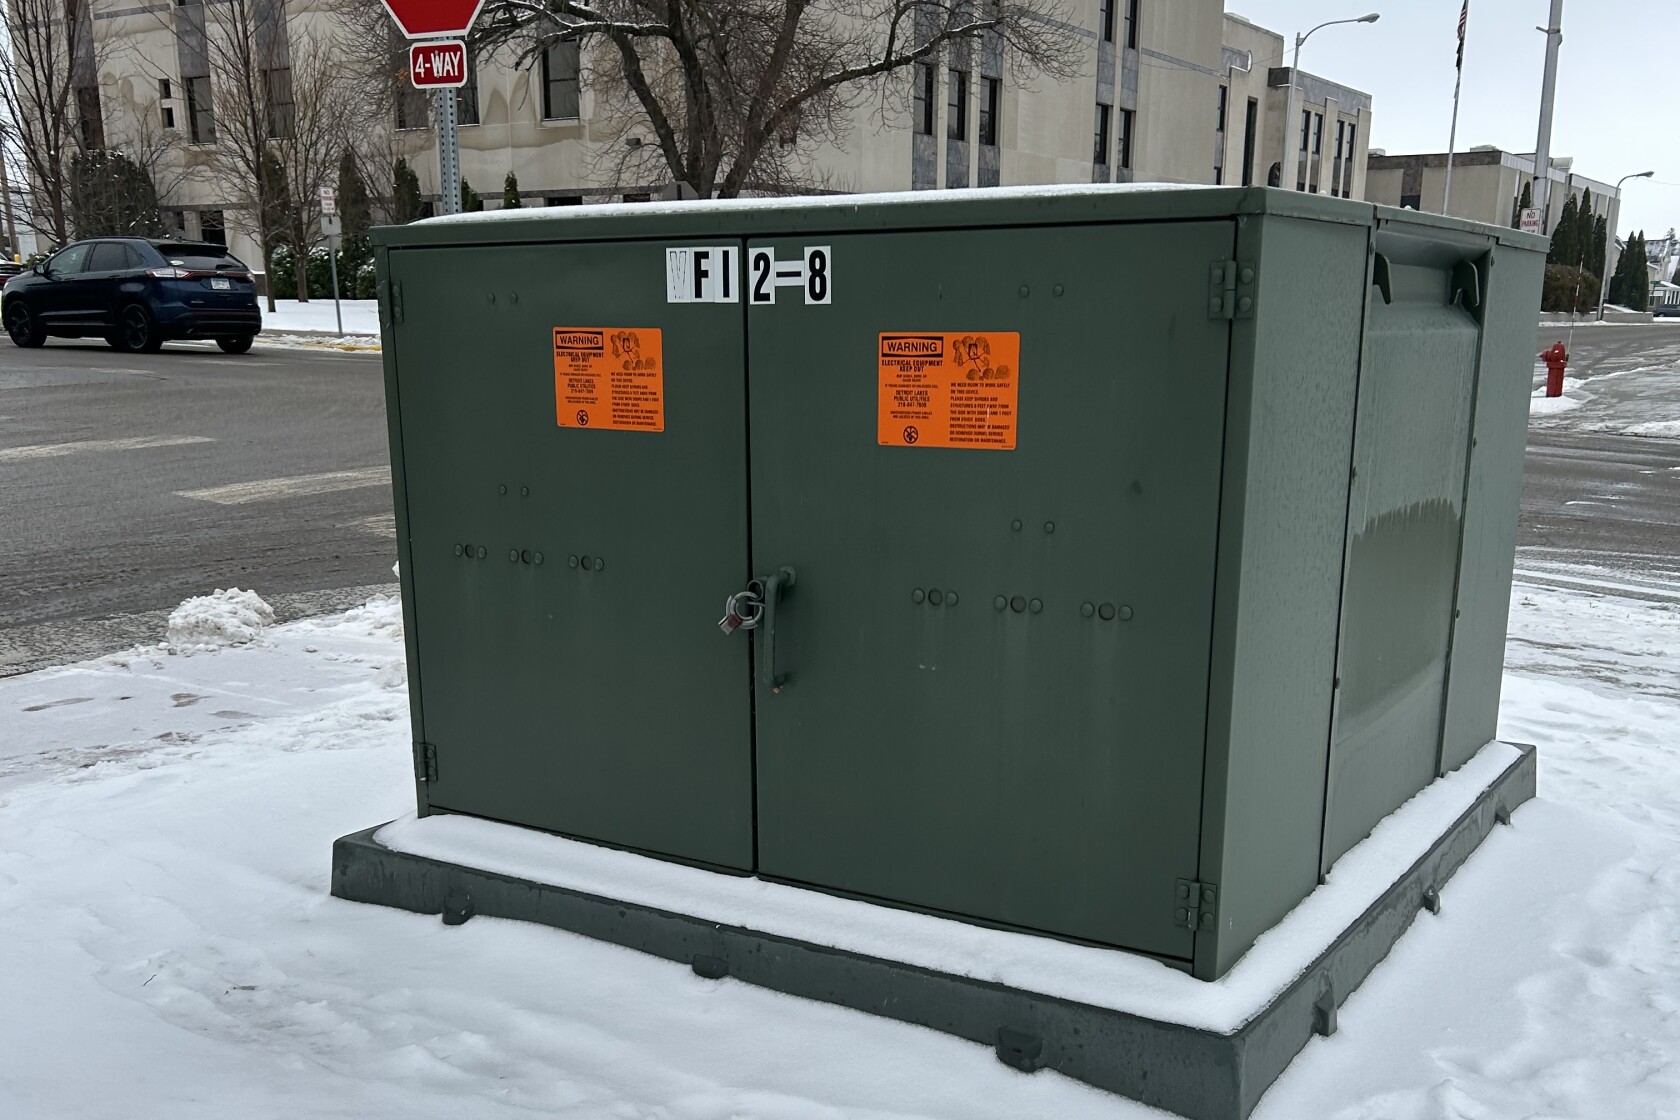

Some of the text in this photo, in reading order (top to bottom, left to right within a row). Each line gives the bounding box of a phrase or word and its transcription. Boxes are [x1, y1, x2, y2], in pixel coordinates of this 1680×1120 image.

[415, 51, 460, 78] 4-WAY
[754, 250, 827, 302] 2-8
[560, 336, 599, 345] WARNING
[887, 342, 937, 352] WARNING
